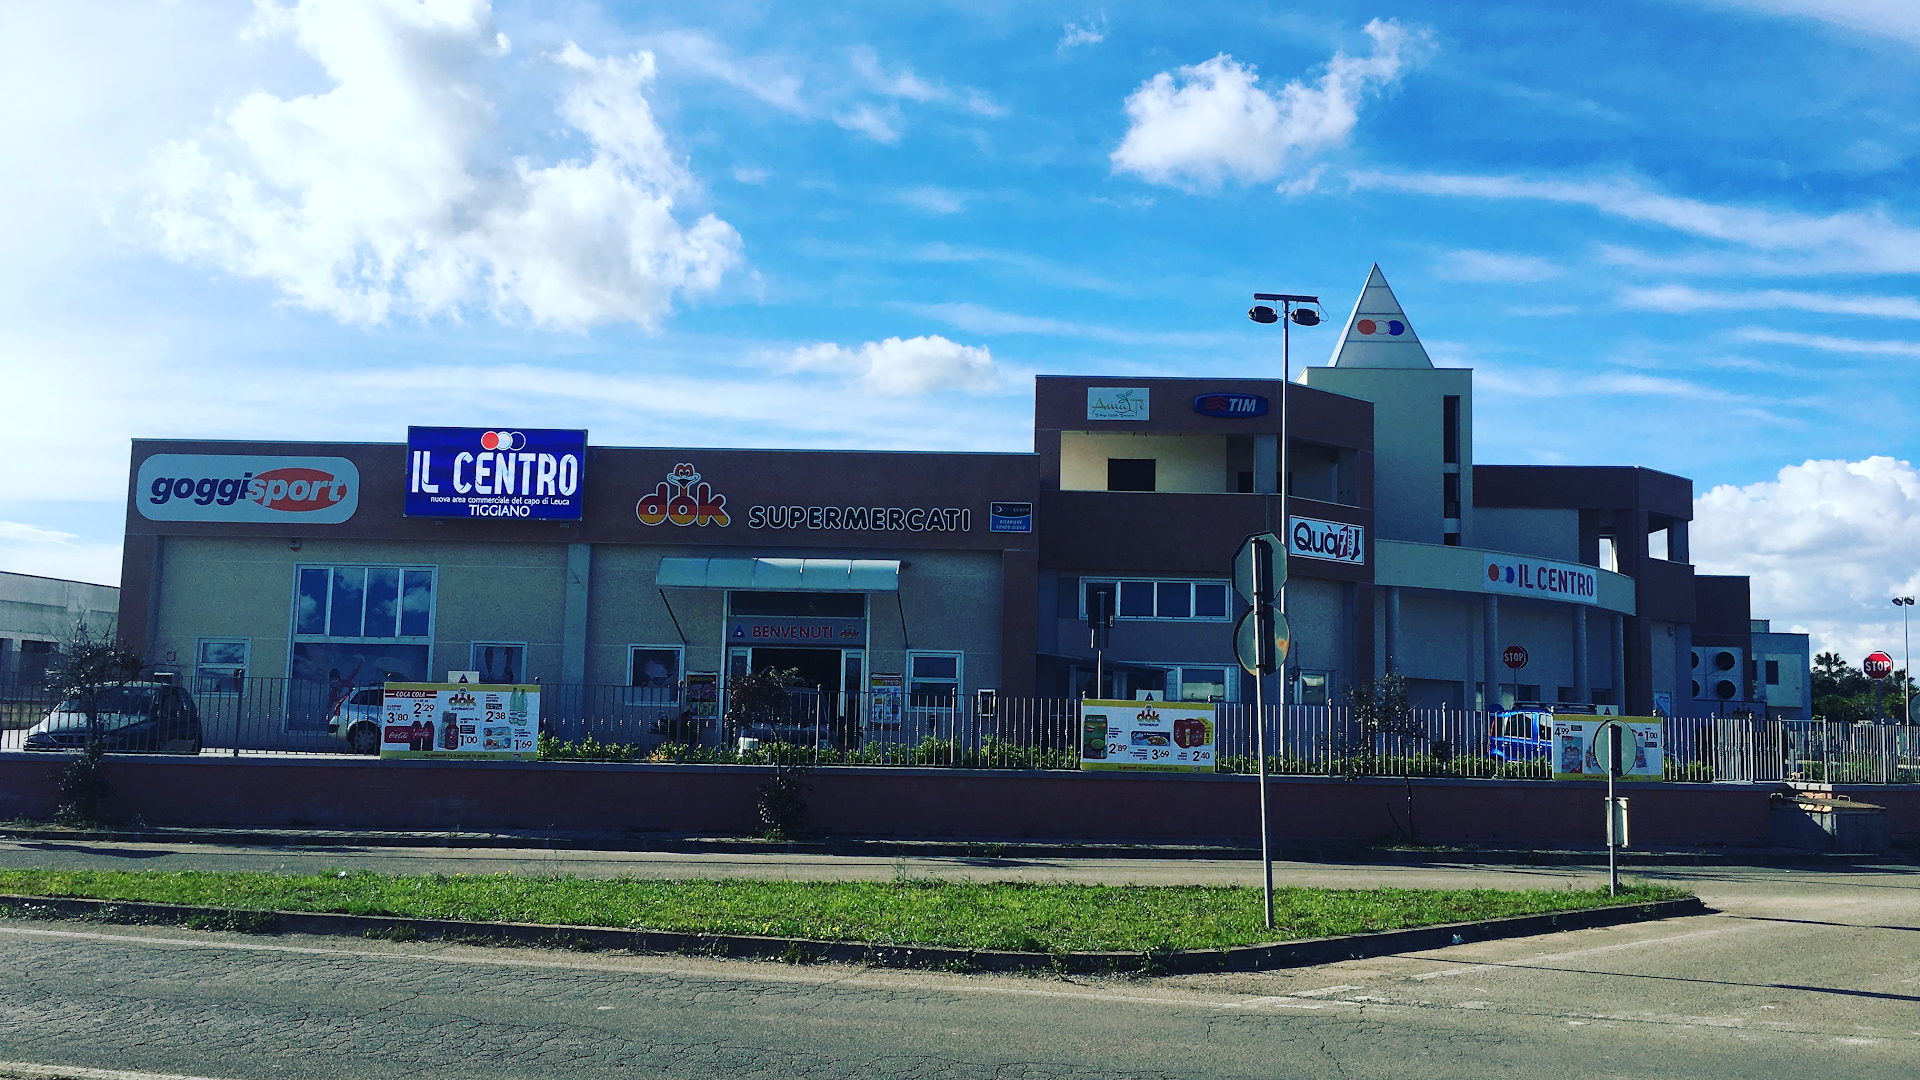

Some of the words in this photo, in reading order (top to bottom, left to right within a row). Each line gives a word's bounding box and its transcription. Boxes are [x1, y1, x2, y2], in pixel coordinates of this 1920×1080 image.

[1229, 398, 1257, 412] TIM
[411, 450, 440, 494] IL
[453, 451, 579, 496] CENTRO
[150, 472, 345, 507] goggisport
[468, 496, 510, 504] commerciale
[512, 496, 523, 504] del
[524, 498, 540, 506] capo
[542, 497, 549, 505] di
[636, 481, 731, 527] dok
[468, 504, 530, 517] TIGGIANO
[748, 505, 971, 531] SUPERMERCATI
[1518, 563, 1534, 589] IL
[1537, 566, 1594, 597] CENTRO
[752, 625, 833, 639] BENVENUTI
[1504, 652, 1524, 662] STOP
[1865, 660, 1891, 672] STOP
